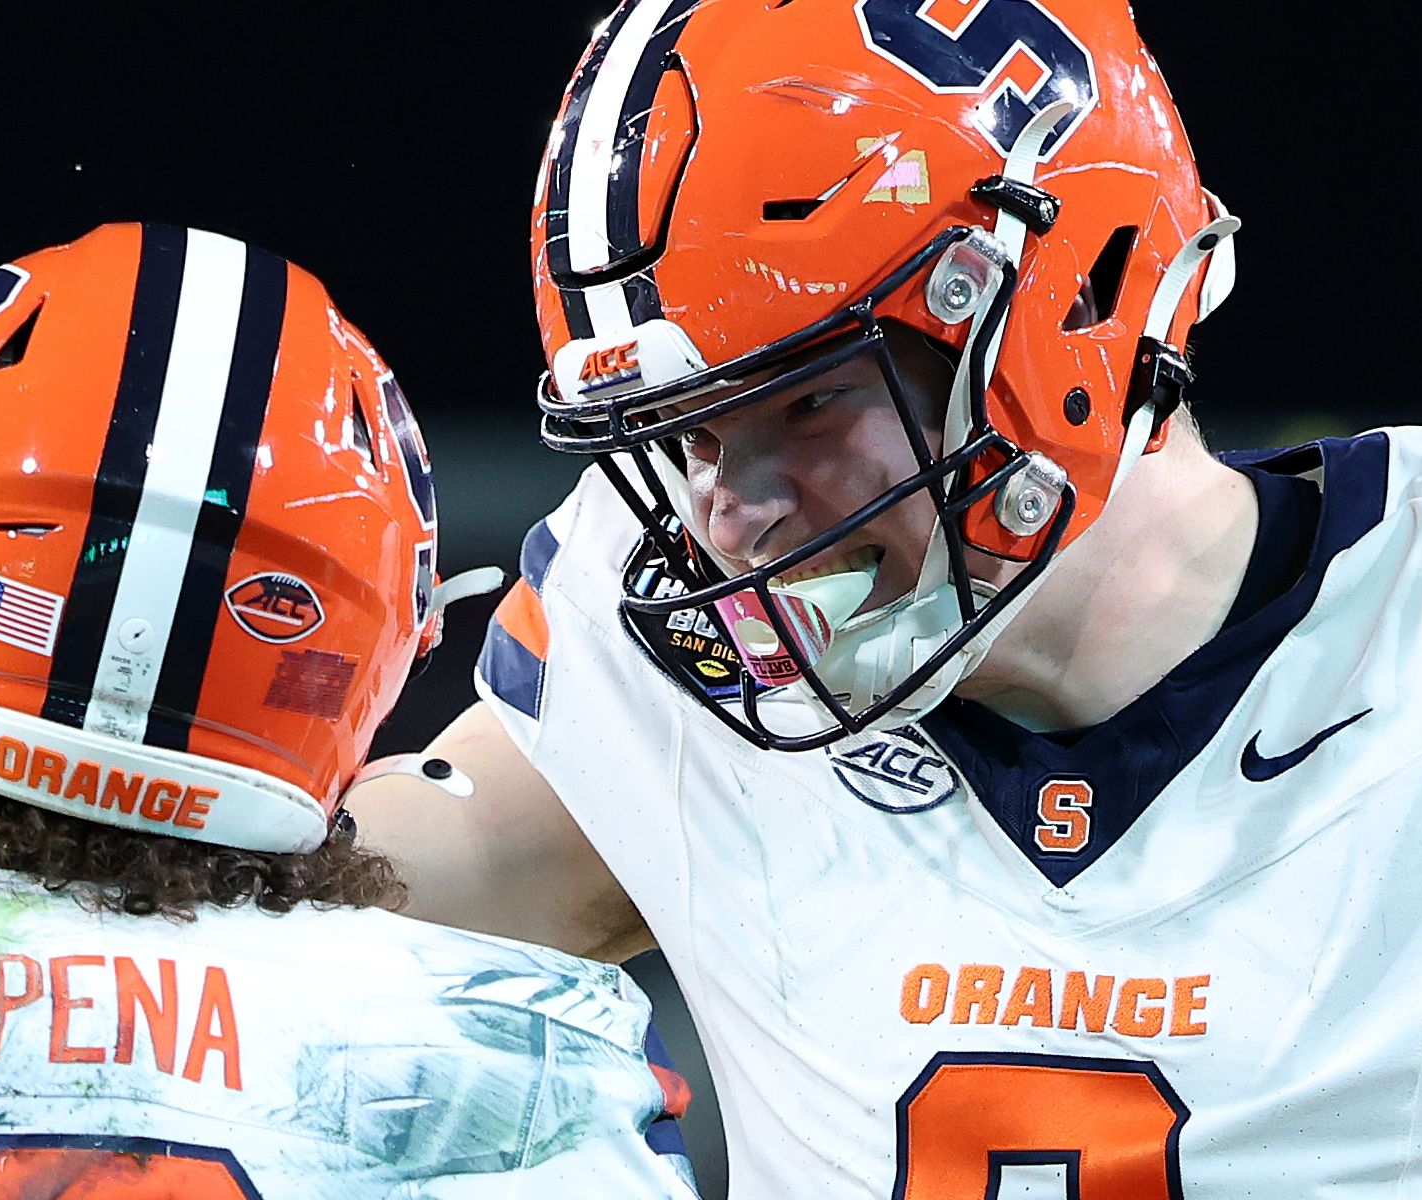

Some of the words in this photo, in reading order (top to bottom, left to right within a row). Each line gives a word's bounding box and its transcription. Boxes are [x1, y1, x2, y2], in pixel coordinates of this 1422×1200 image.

[579, 340, 639, 380] ACC
[670, 632, 706, 653] SAN
[711, 642, 740, 664] DIE
[841, 742, 946, 788] ACC
[1034, 780, 1093, 852] S
[899, 963, 1211, 1037] ORANGE
